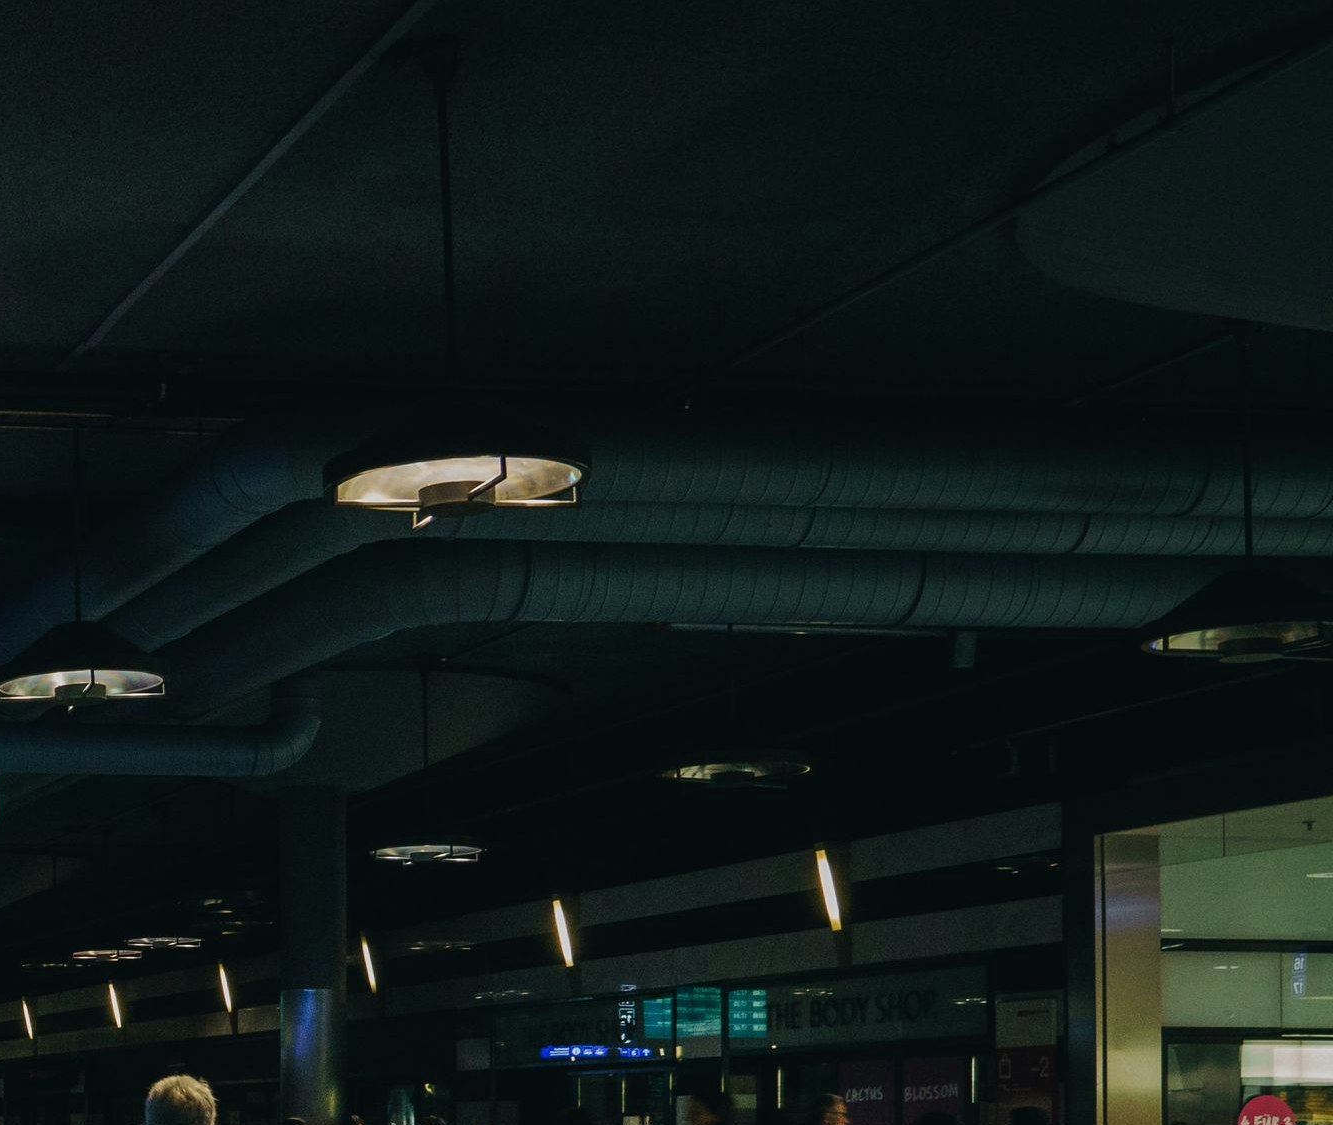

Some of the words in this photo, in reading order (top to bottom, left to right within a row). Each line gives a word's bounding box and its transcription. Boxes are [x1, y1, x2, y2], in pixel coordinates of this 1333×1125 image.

[810, 994, 870, 1028] BODY
[845, 1086, 884, 1103] CACTUS
[904, 1083, 959, 1102] BLOSSOM
